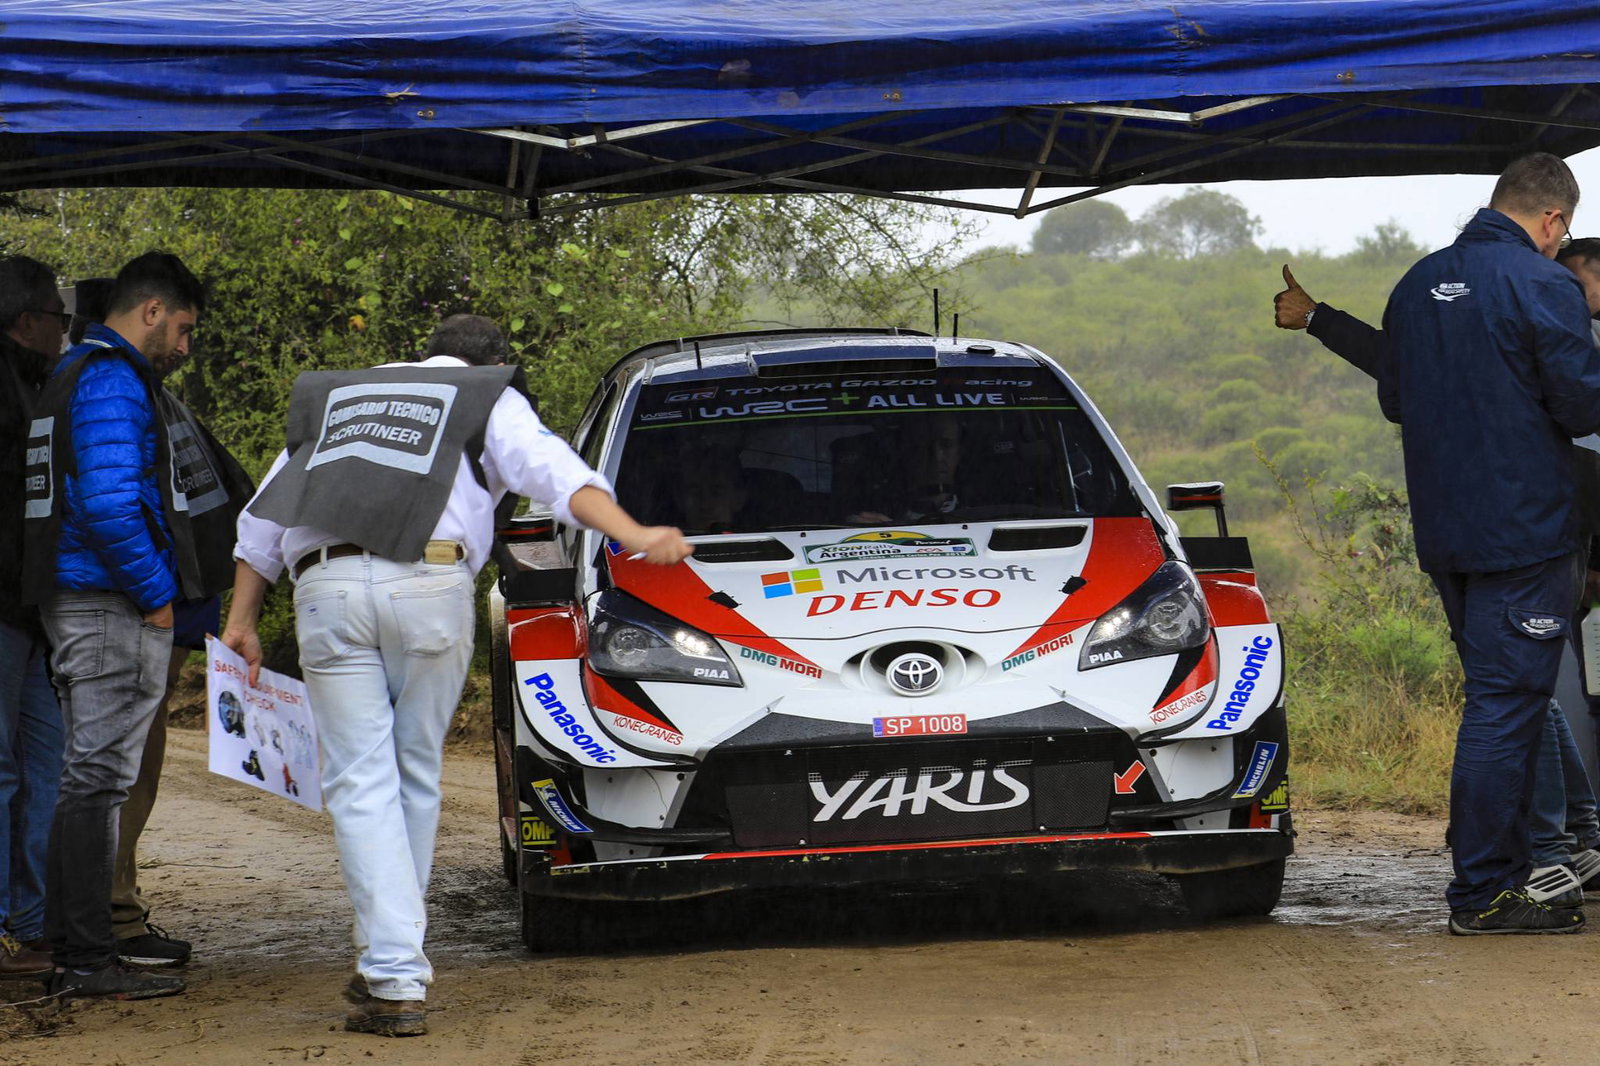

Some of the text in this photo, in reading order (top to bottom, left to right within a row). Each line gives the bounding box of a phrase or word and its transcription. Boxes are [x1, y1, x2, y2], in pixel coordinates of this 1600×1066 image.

[668, 391, 714, 401] GR
[726, 382, 833, 396] TOYOTA
[840, 378, 937, 388] GAZOO
[867, 394, 927, 408] ALL
[936, 393, 1006, 406] LIVE
[328, 401, 441, 428] COMISARIO TECNICO
[326, 422, 423, 446] SCRUTINEER
[820, 548, 901, 559] Argentina
[836, 565, 1037, 585] Microsoft
[806, 588, 1002, 617] DENSO
[740, 647, 823, 679] DMG MORI
[1001, 633, 1074, 672] DMG MORI
[1089, 650, 1123, 664] PIAA
[693, 667, 730, 680] PIAA
[1206, 636, 1273, 730] Panasonic
[524, 672, 617, 764] Panasonic
[1150, 690, 1208, 725] KONECRANES
[613, 715, 684, 746] KONECRANES
[886, 715, 963, 735] SP 1008
[1247, 748, 1270, 788] MICHELIN
